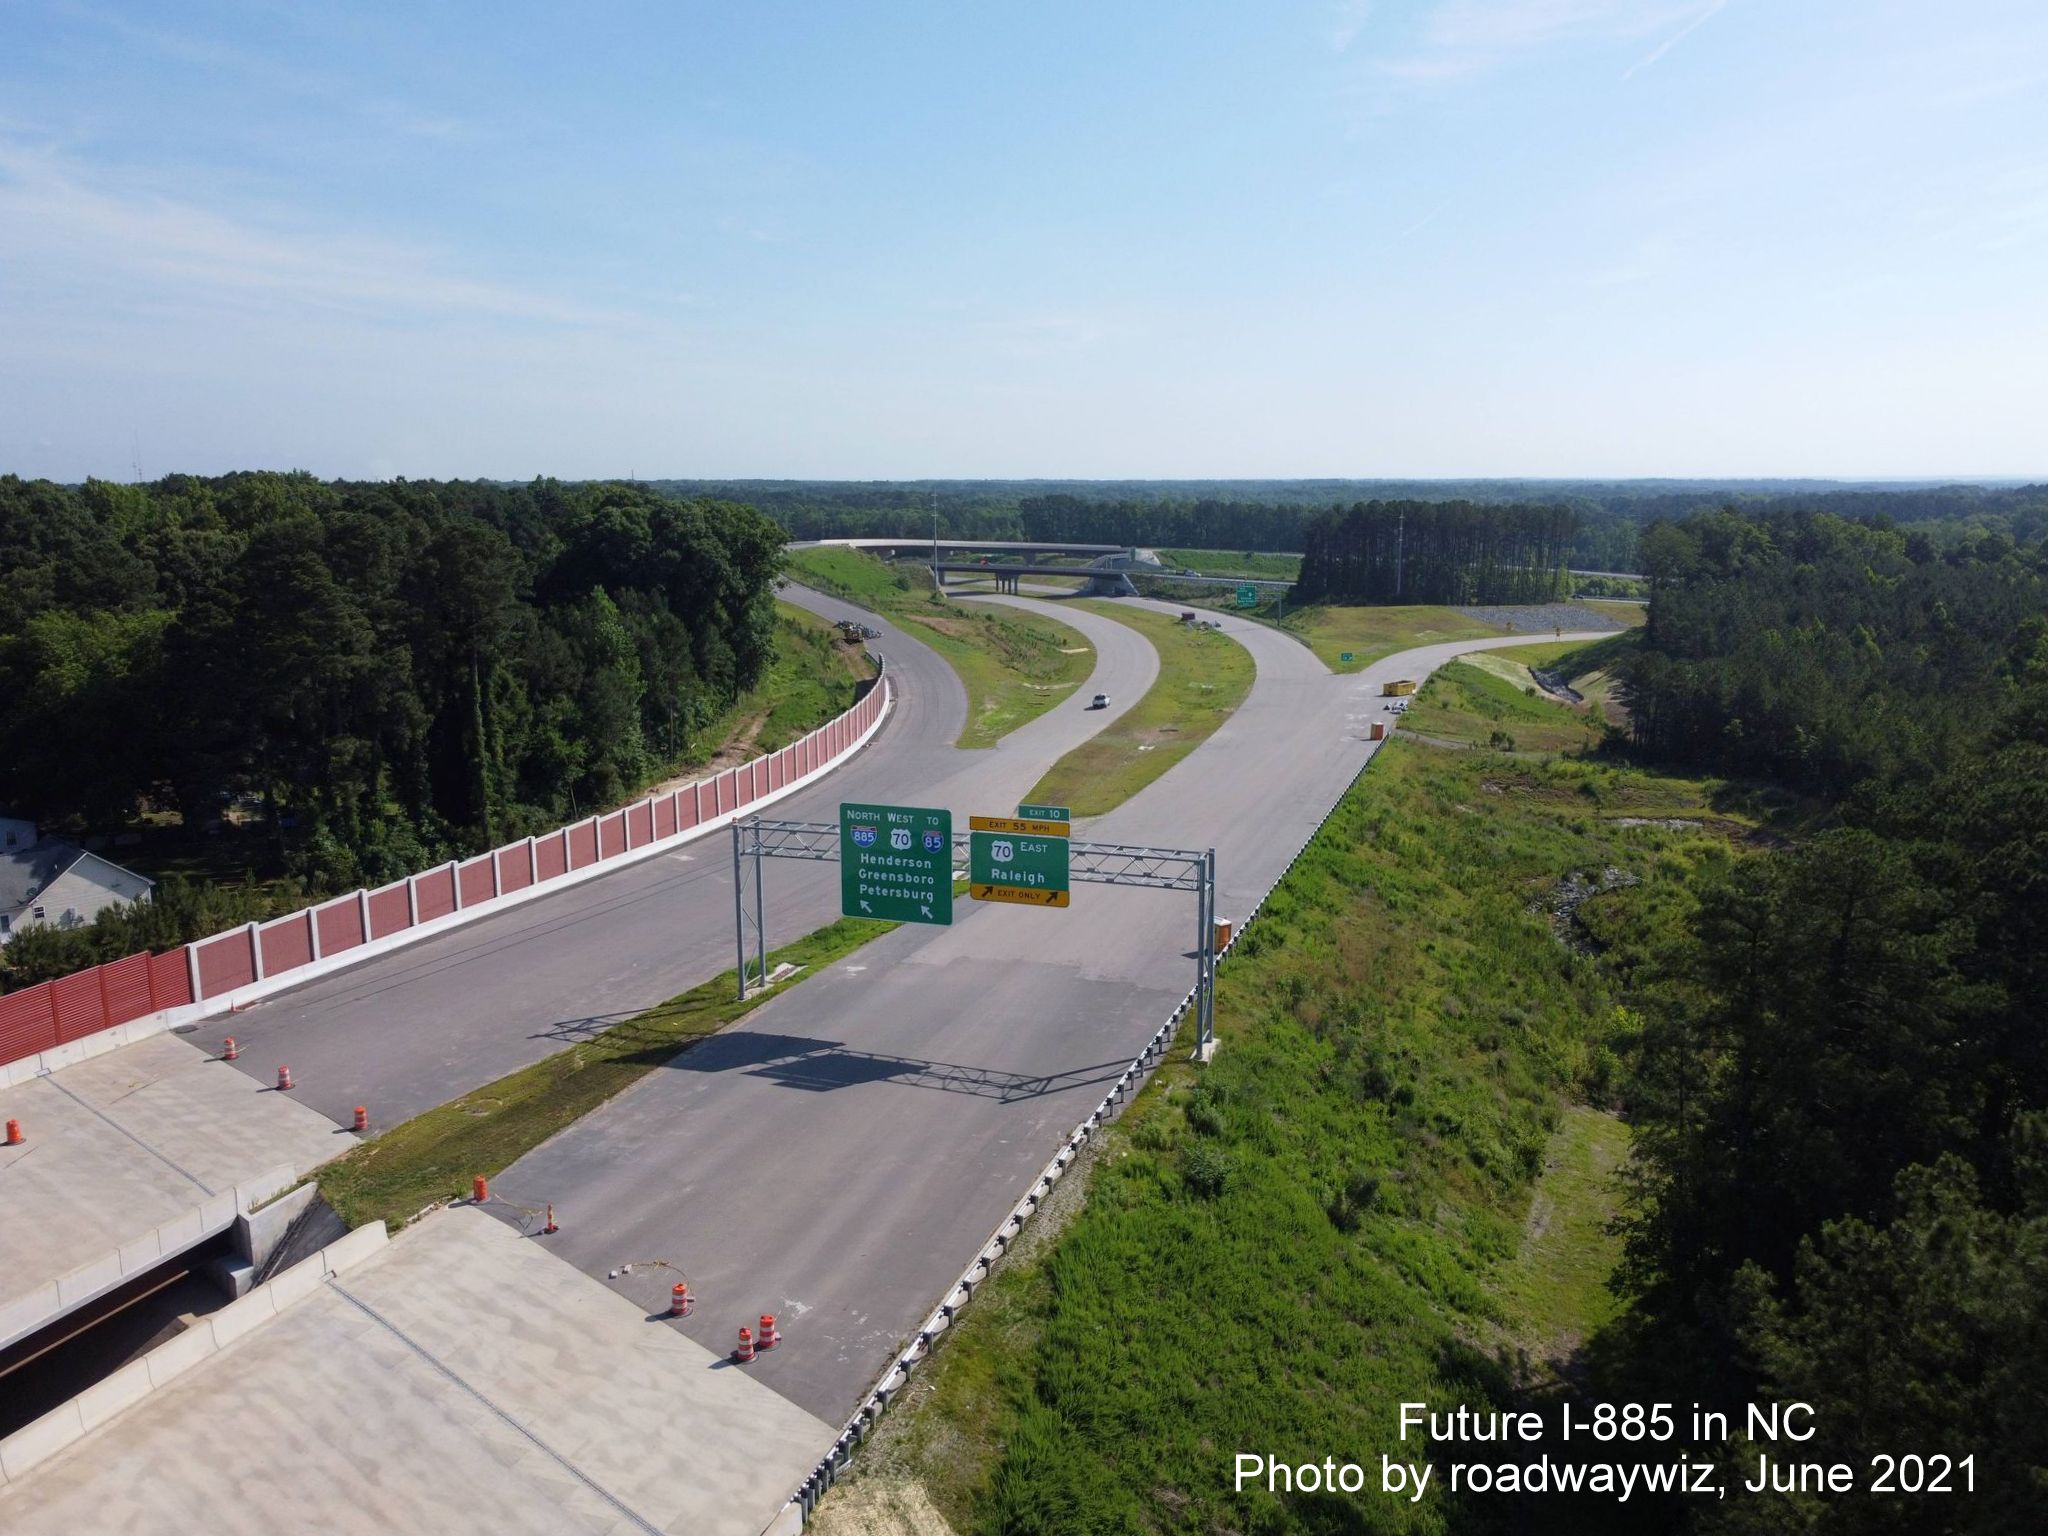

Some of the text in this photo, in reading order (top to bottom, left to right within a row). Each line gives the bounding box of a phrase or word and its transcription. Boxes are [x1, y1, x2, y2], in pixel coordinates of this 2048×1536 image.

[847, 810, 939, 825] NORTH WEST TO
[1049, 810, 1060, 819] 10
[989, 821, 1050, 832] EXIT 55 MPH
[854, 831, 875, 842] 885
[893, 833, 909, 846] 70
[925, 837, 941, 848] 85
[993, 841, 1048, 858] 70 EAST
[860, 853, 932, 869] Henderson
[858, 868, 934, 885] Greensboro
[991, 868, 1045, 885] Raleigh
[859, 884, 934, 904] Petersburg
[997, 889, 1041, 900] EXIT ONLY
